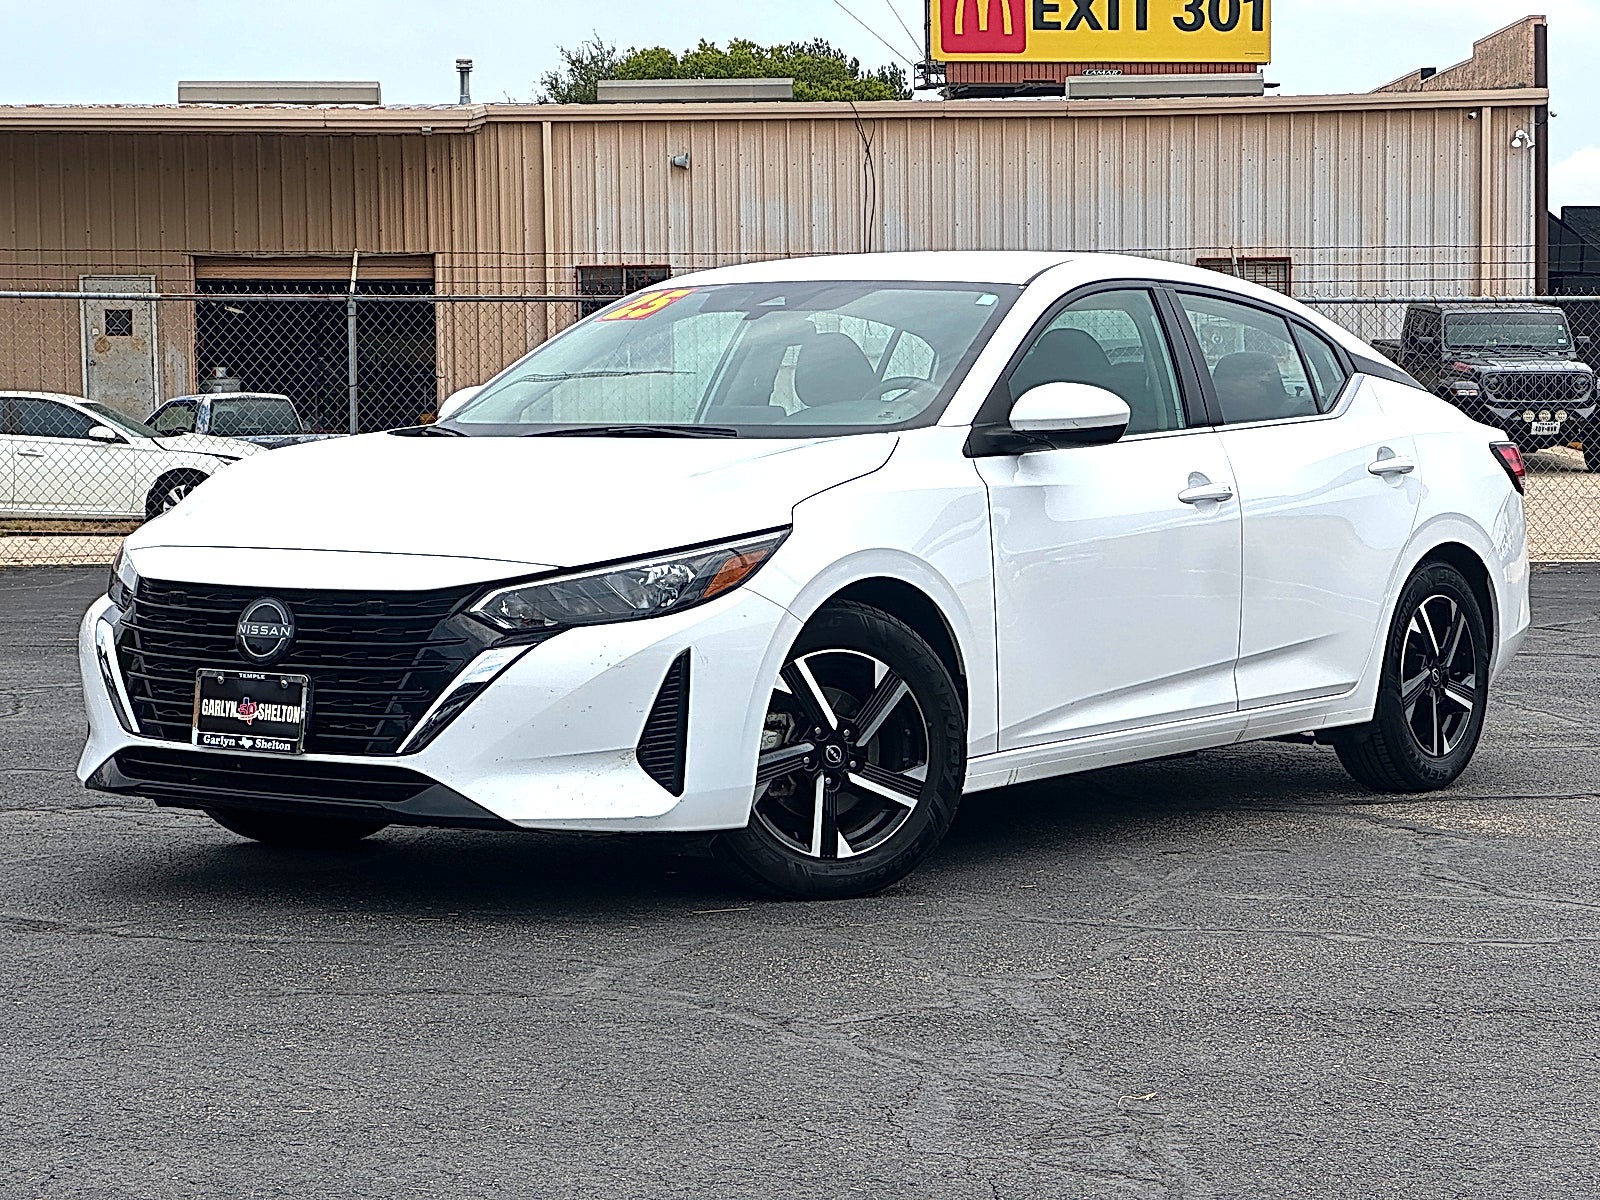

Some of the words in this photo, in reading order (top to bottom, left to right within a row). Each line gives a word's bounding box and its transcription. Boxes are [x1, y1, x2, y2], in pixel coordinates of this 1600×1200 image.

[1172, 0, 1264, 32] 301
[238, 624, 291, 637] NISSAN
[239, 672, 266, 680] TEMPLE
[201, 698, 238, 718] GARLYN
[257, 703, 301, 724] SHELTON
[203, 734, 236, 748] Garlyn
[254, 738, 291, 751] Shelton
